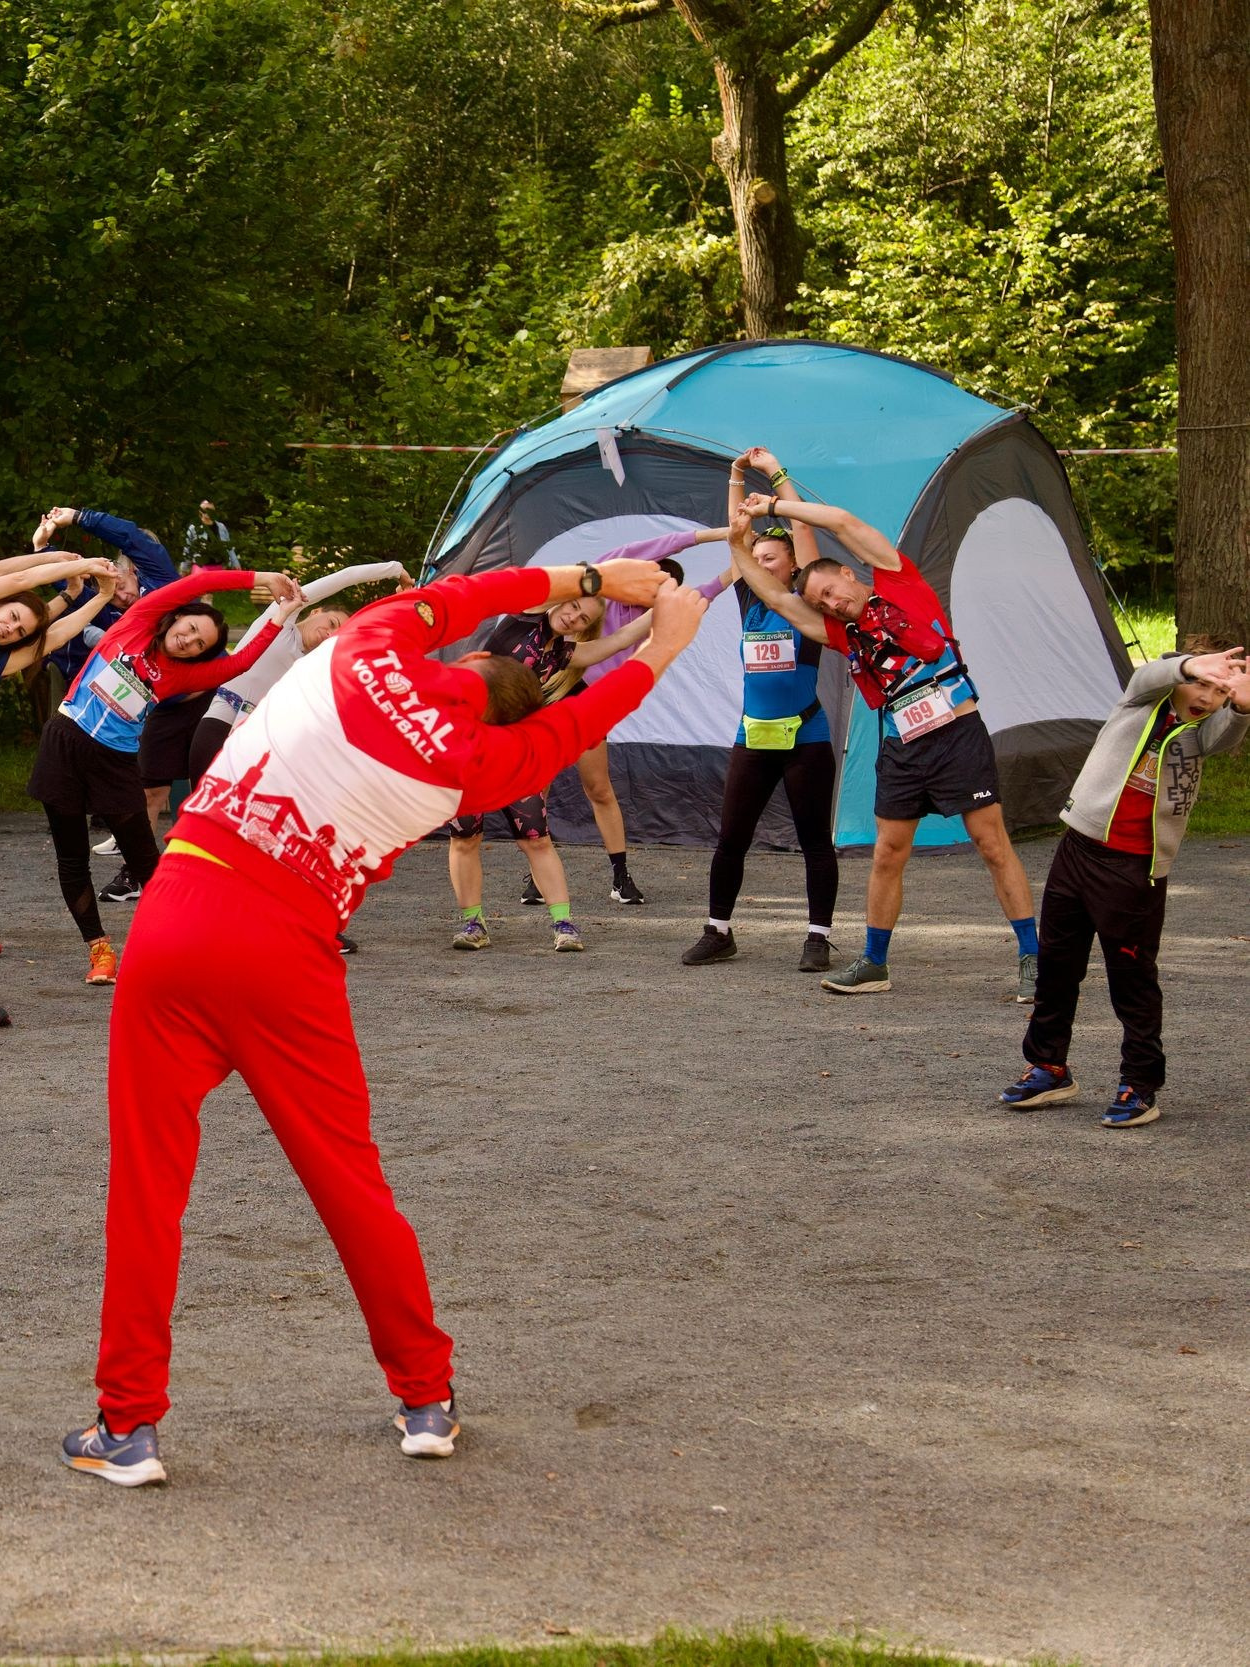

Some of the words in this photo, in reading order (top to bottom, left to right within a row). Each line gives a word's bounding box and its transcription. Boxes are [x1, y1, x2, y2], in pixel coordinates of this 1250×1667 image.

[754, 643, 781, 661] 129
[112, 682, 132, 702] 17
[352, 658, 435, 764] VOLLEYBALL
[902, 700, 934, 727] 169
[973, 790, 992, 800] FILA
